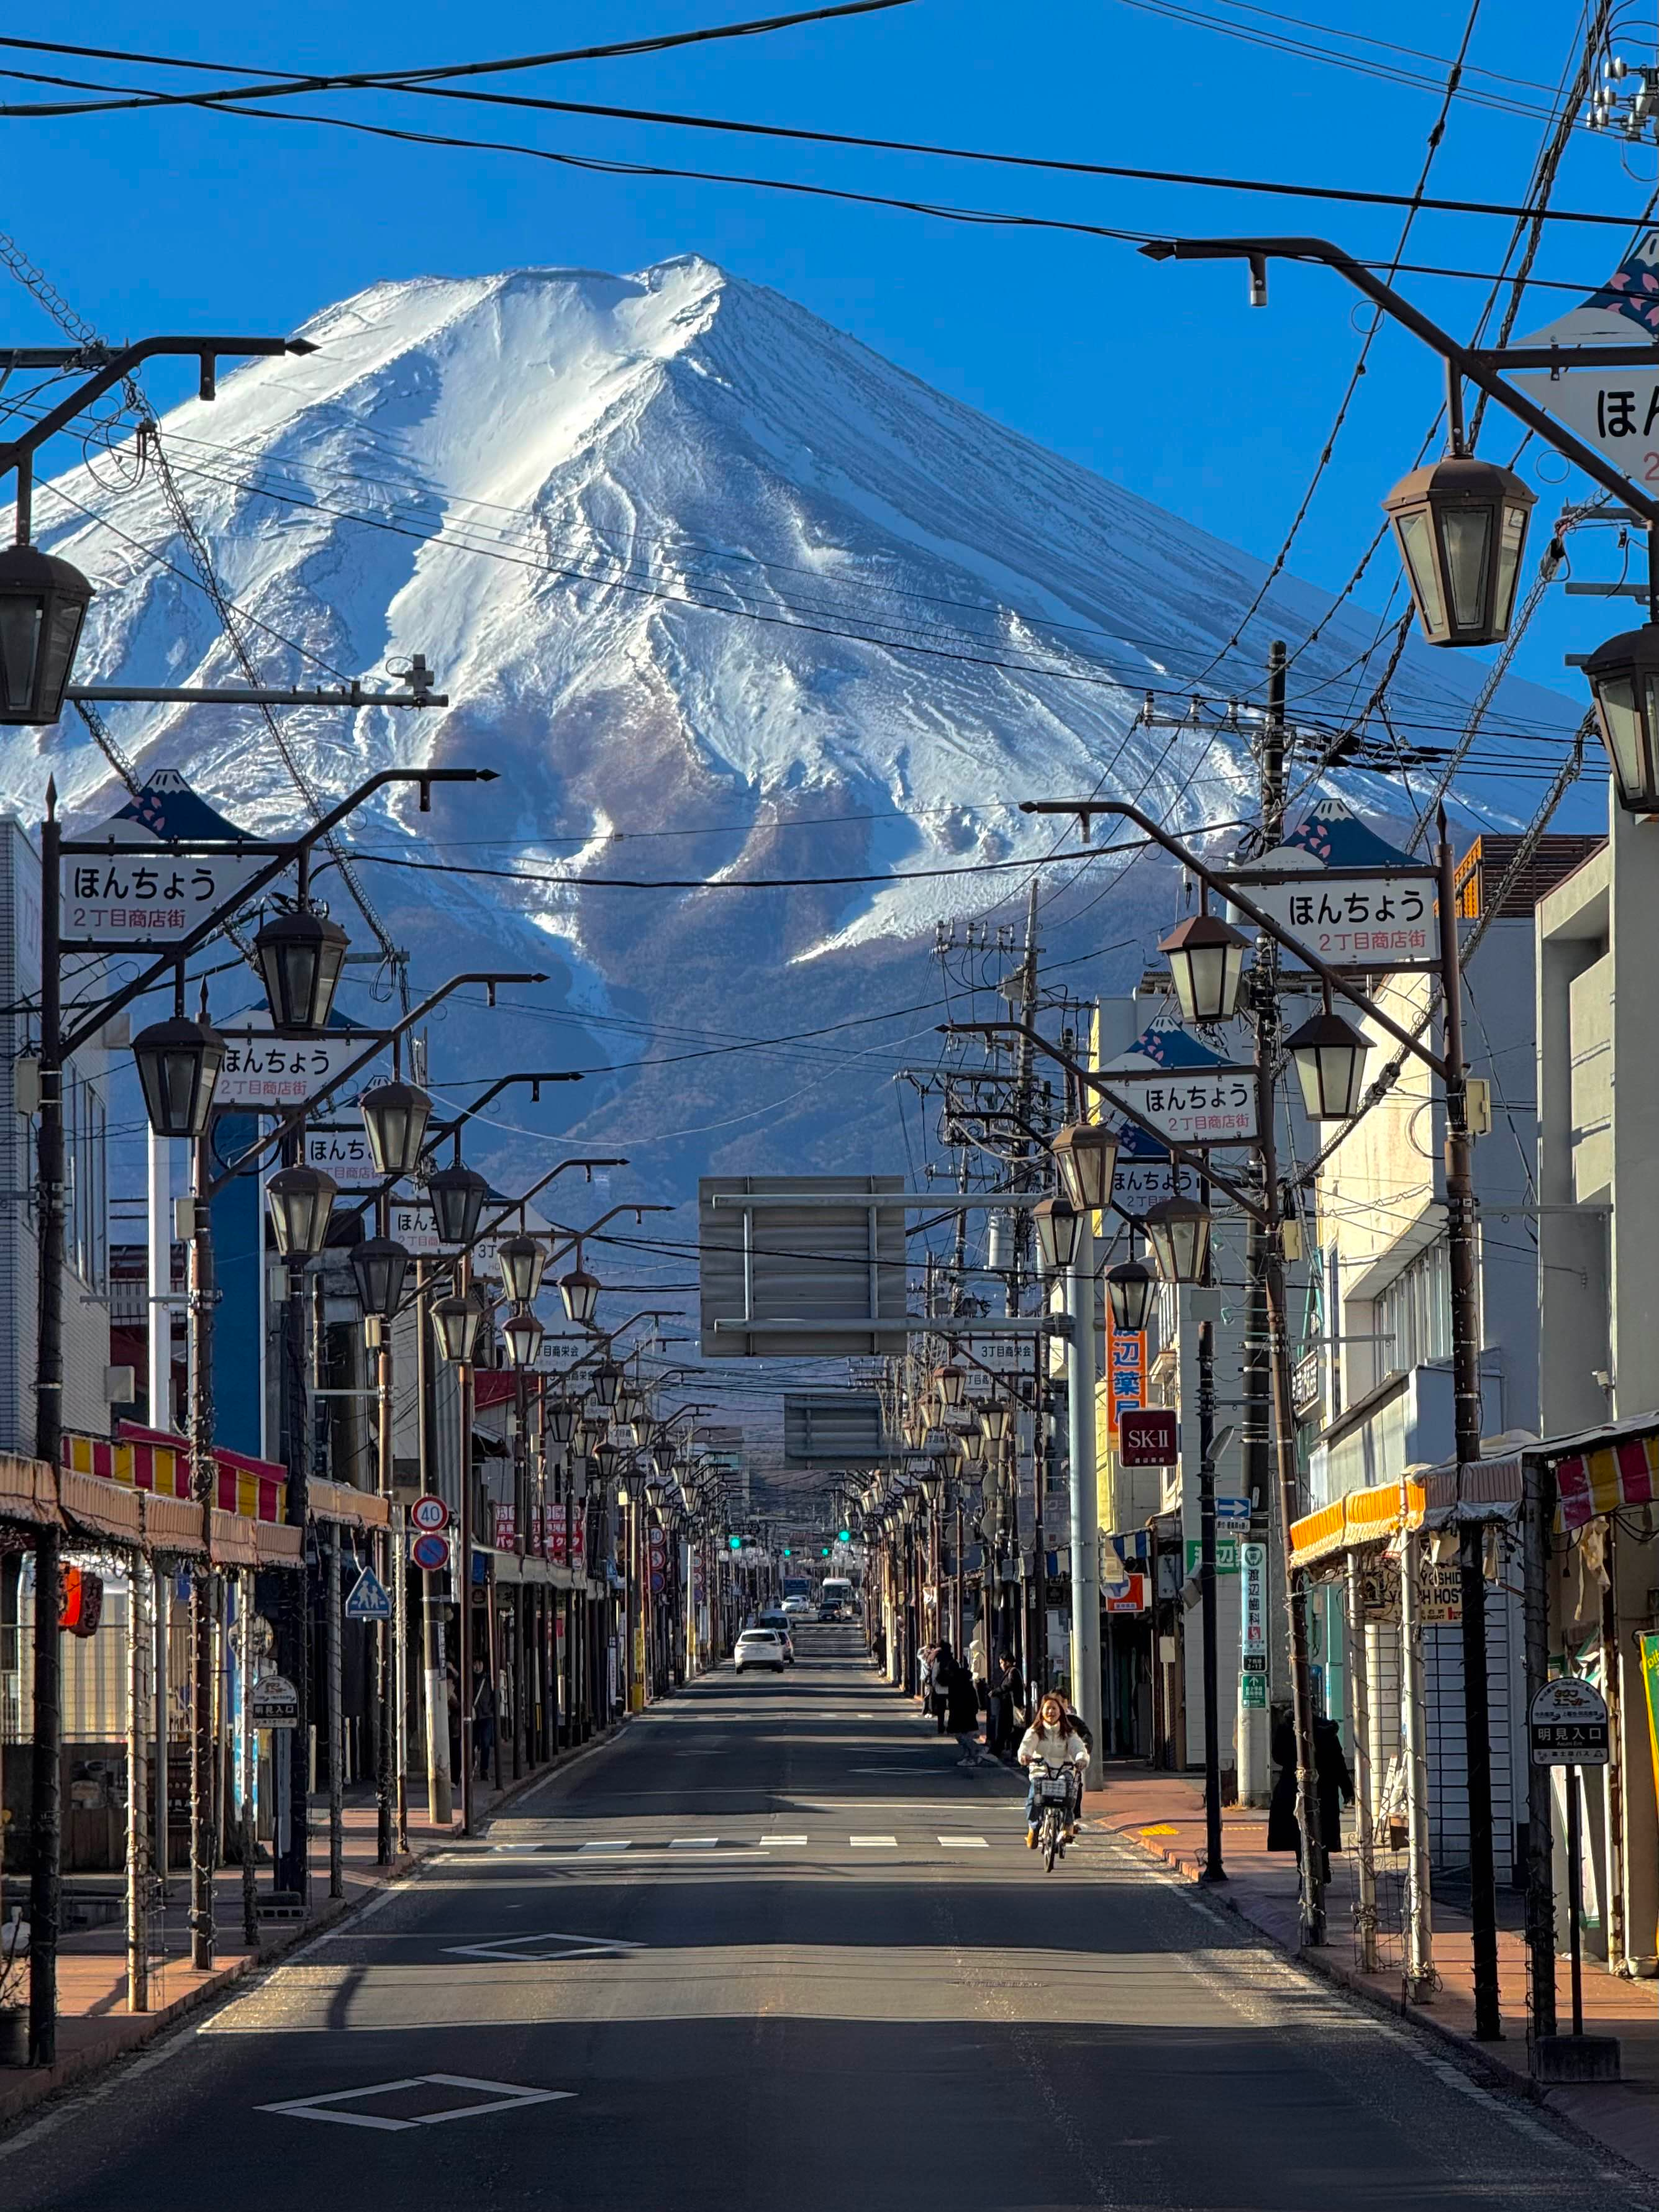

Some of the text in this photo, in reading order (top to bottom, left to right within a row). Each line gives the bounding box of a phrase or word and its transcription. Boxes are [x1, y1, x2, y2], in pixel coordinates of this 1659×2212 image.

[75, 866, 215, 901] ほんちょう
[1290, 890, 1424, 925] ほんちょう
[74, 908, 185, 928] 2丁目商店街
[1319, 930, 1426, 951] 2丁目商店街
[222, 1048, 329, 1075] ほんちょう
[221, 1079, 307, 1095] 2丁目商店街
[1147, 1083, 1247, 1112] ほんちょう
[1169, 1113, 1249, 1131] 2丁目商店街
[311, 1139, 372, 1160] ほんち
[981, 1346, 1031, 1358] 3丁目商栄会
[1129, 1430, 1169, 1448] SK-II
[422, 1506, 440, 1521] 40
[1538, 1728, 1602, 1741] 明見入口
